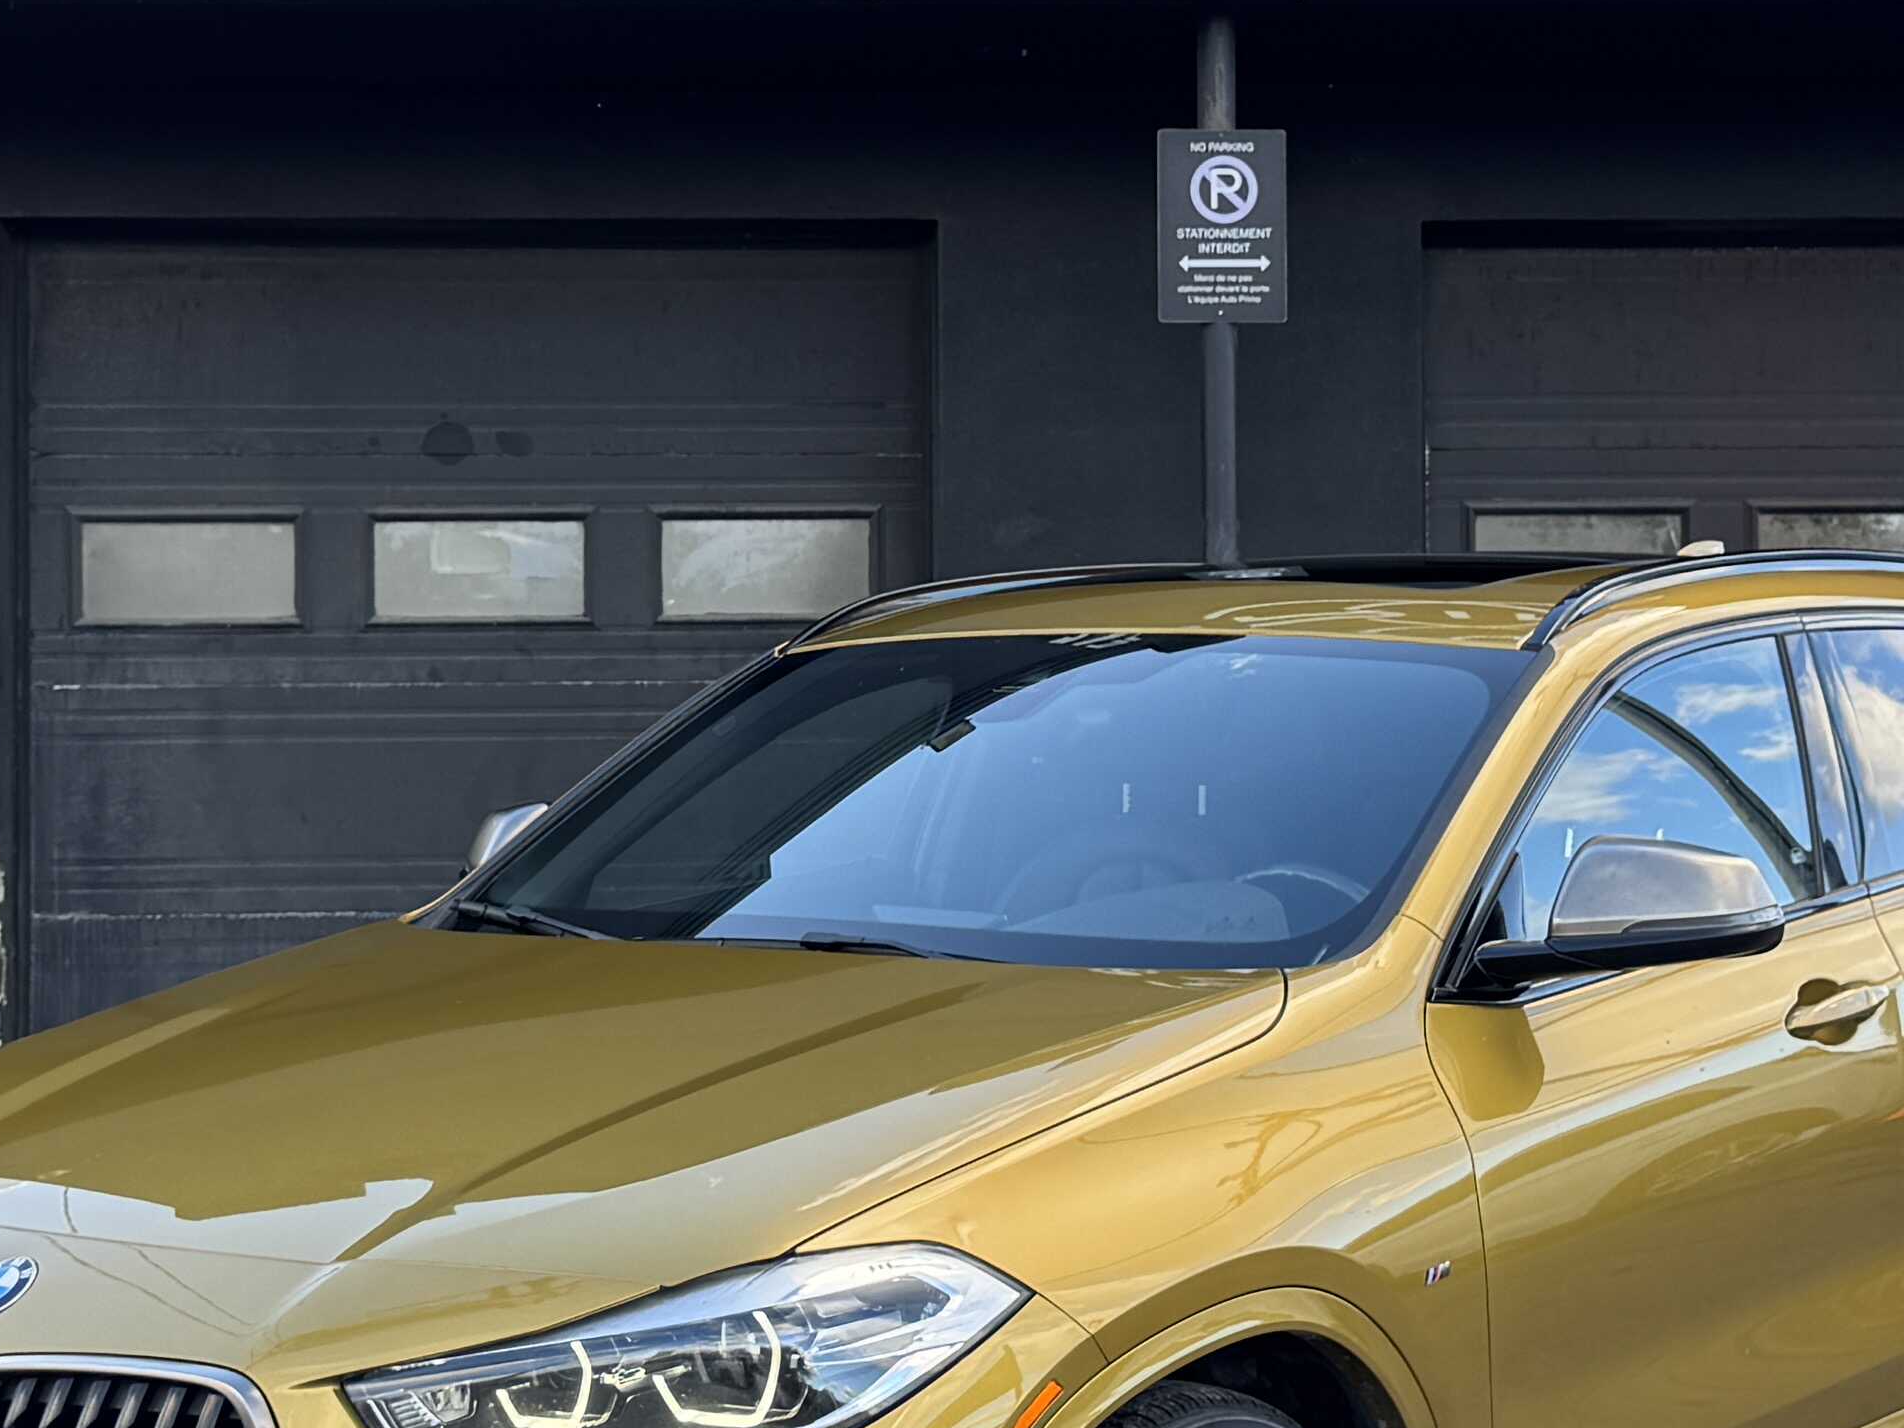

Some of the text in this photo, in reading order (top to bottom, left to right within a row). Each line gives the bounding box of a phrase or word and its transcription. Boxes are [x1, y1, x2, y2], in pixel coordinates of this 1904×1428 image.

[1190, 142, 1254, 152] NO PARKING
[1176, 228, 1272, 240] STATIONNEMENT
[1198, 243, 1251, 254] INTERDIT
